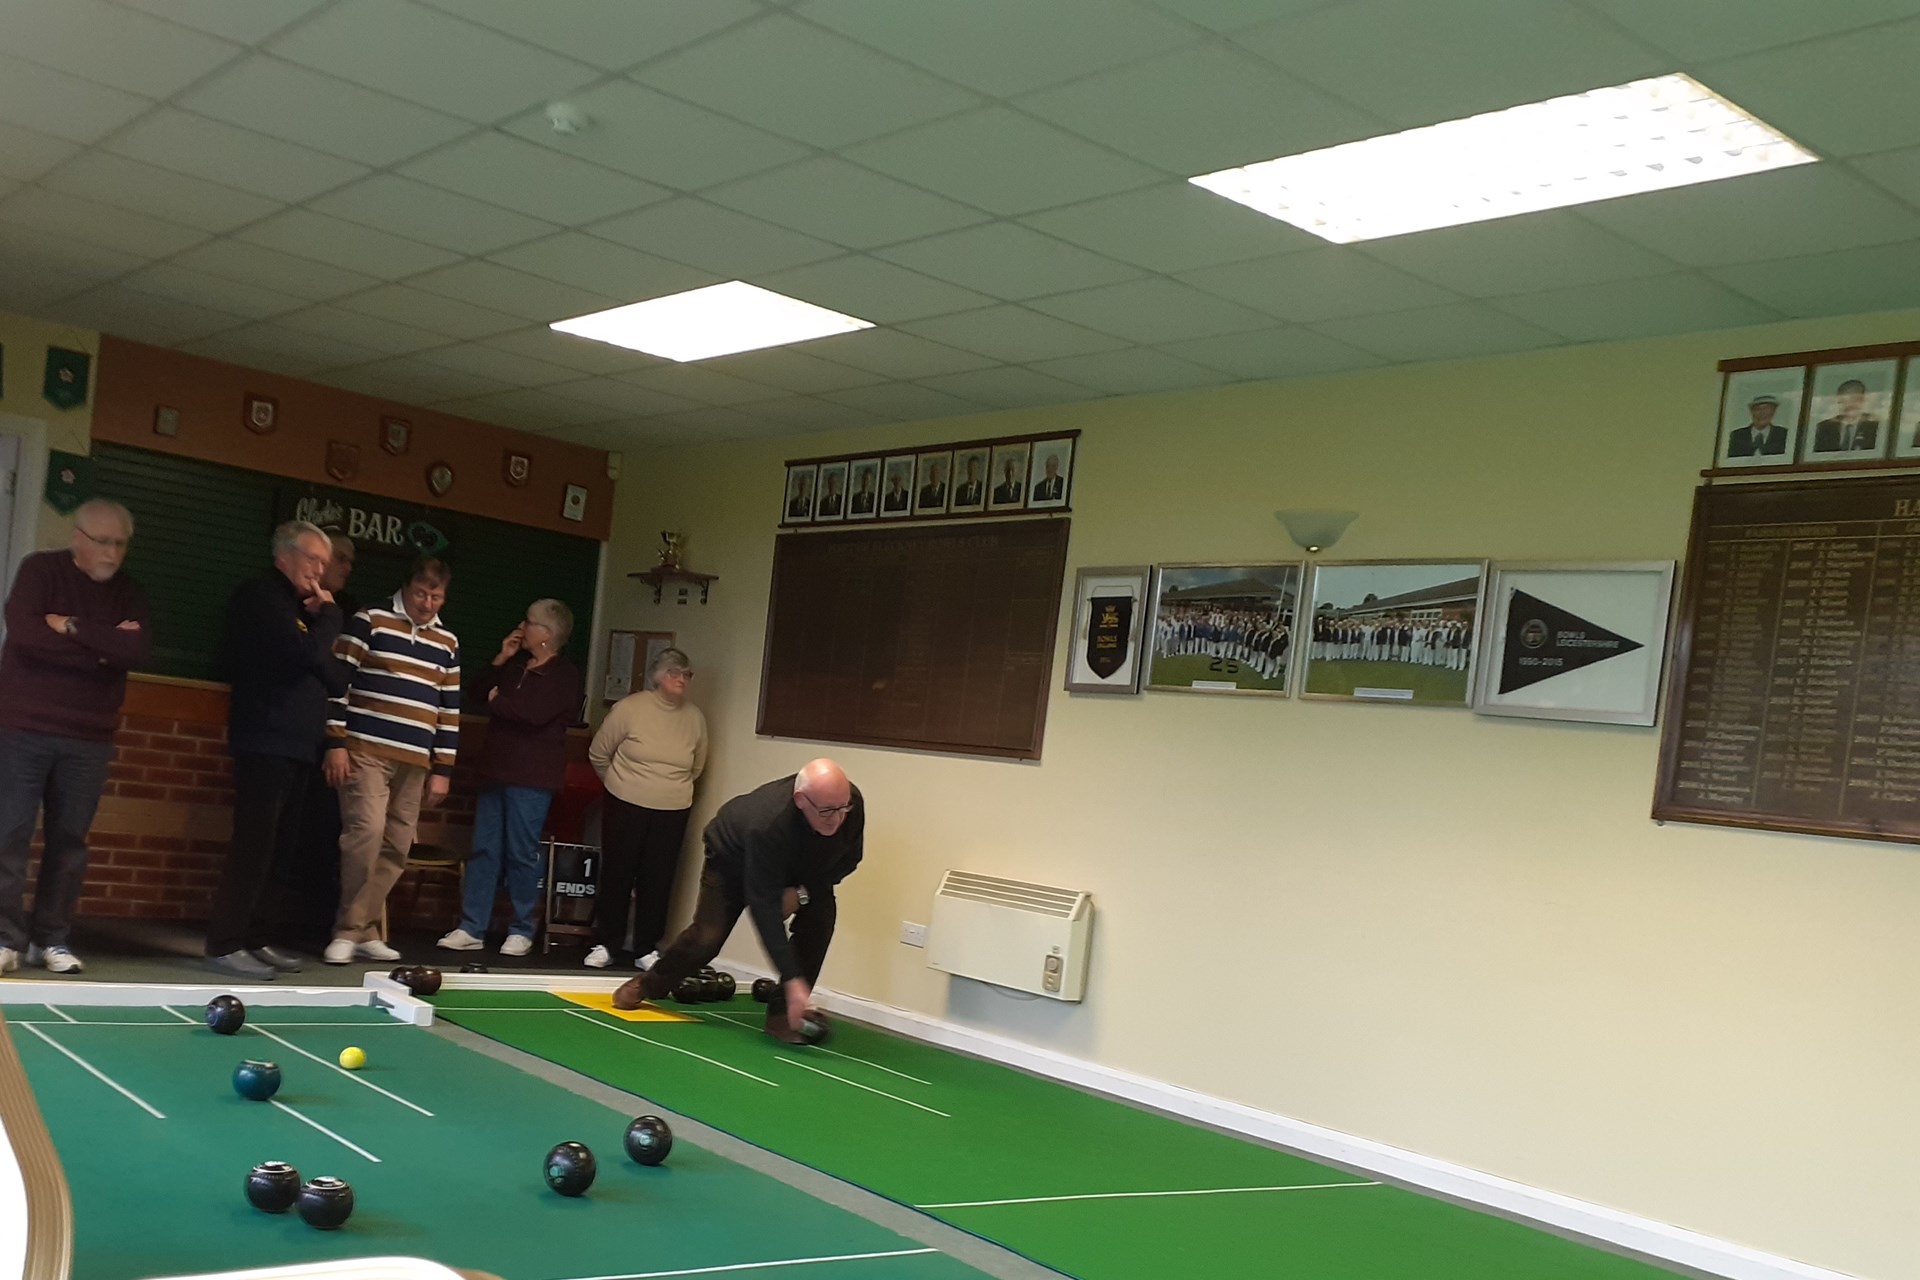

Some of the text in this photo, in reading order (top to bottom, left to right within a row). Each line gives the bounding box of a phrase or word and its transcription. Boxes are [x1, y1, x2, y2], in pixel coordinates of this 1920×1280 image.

[348, 507, 404, 546] BAR
[584, 858, 592, 878] 1
[556, 882, 596, 895] ENDS
